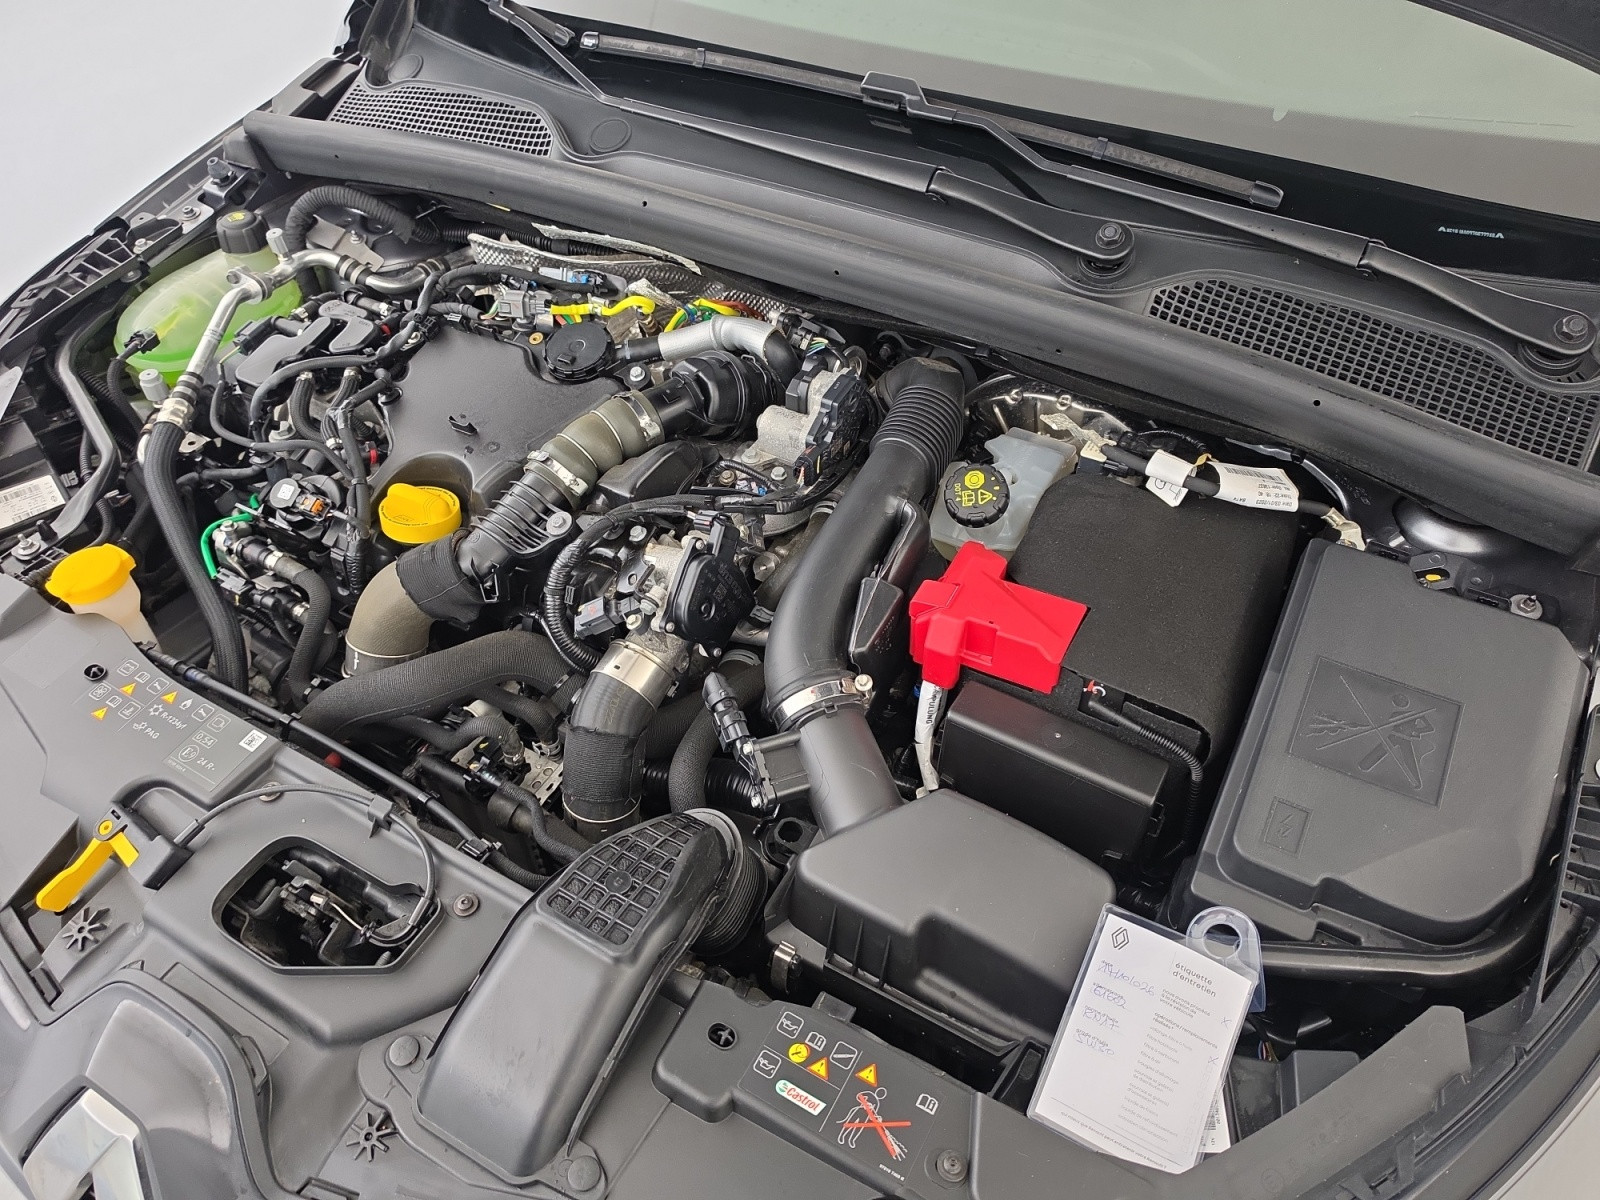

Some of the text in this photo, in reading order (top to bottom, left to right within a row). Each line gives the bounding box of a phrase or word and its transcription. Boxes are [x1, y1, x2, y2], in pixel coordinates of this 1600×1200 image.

[954, 483, 962, 495] DOT
[160, 711, 187, 730] R-1234yf
[1171, 970, 1217, 996] d'entretien
[1175, 962, 1213, 985] étiquette
[786, 1087, 821, 1112] Castrol
